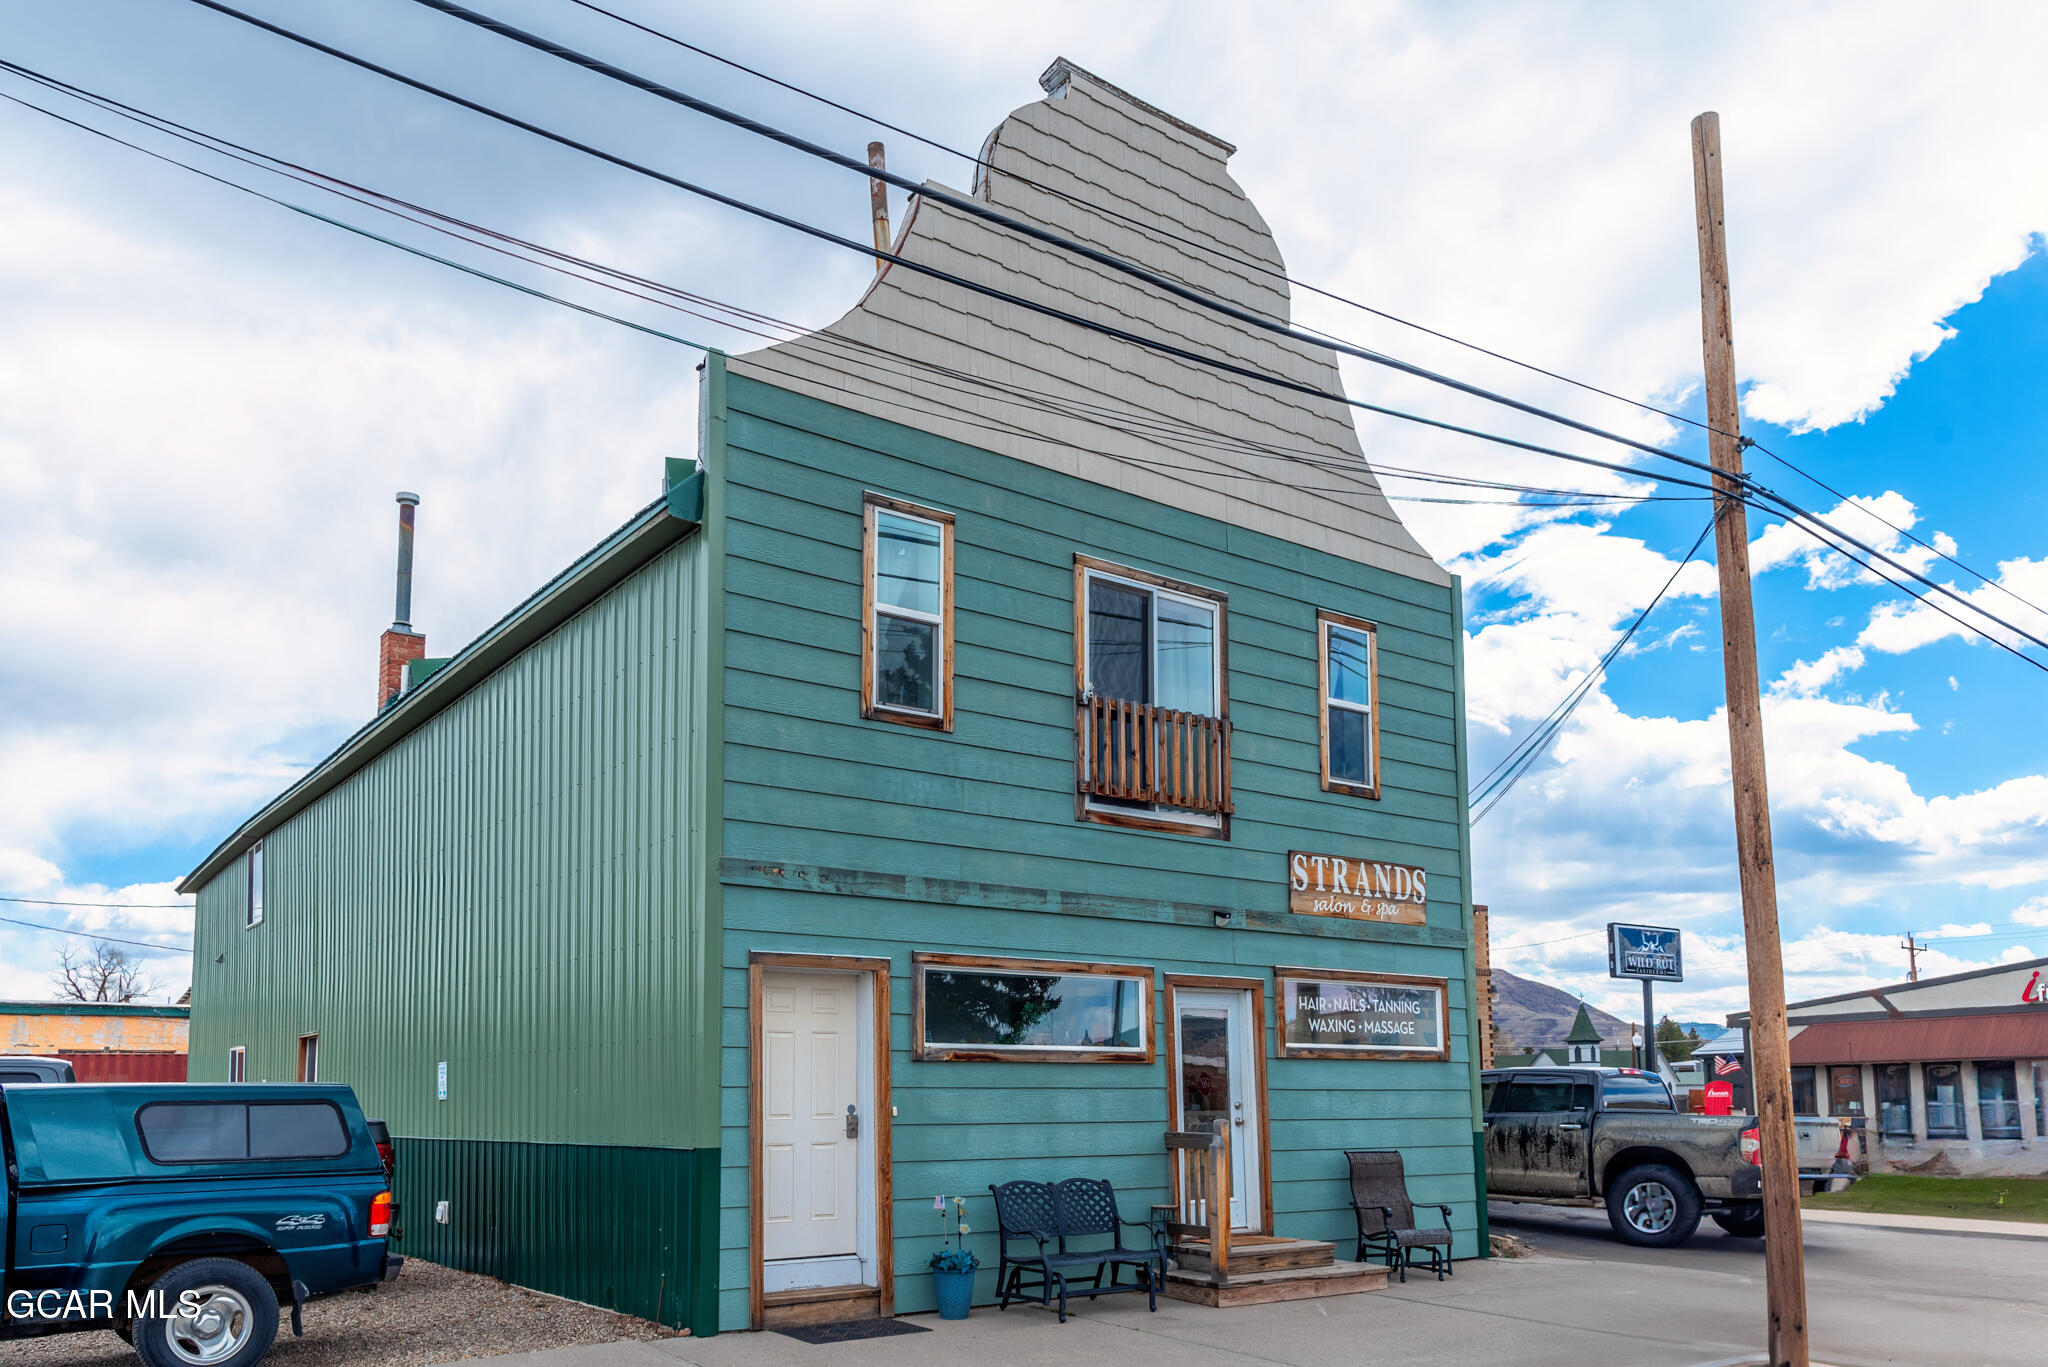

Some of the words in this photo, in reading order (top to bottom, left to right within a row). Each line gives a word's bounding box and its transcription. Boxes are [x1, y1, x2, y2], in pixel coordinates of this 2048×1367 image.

[1293, 854, 1426, 904] STRANDS
[1313, 896, 1355, 913] salon
[1361, 898, 1371, 914] &
[1375, 901, 1399, 920] spa
[1628, 957, 1653, 968] WILD
[1656, 959, 1673, 970] RUT
[1299, 996, 1326, 1011] HAIR
[1333, 998, 1366, 1013] NAILS
[1372, 999, 1421, 1015] TANNING
[1309, 1018, 1356, 1033] WAXING
[1364, 1020, 1415, 1035] MASSAGE
